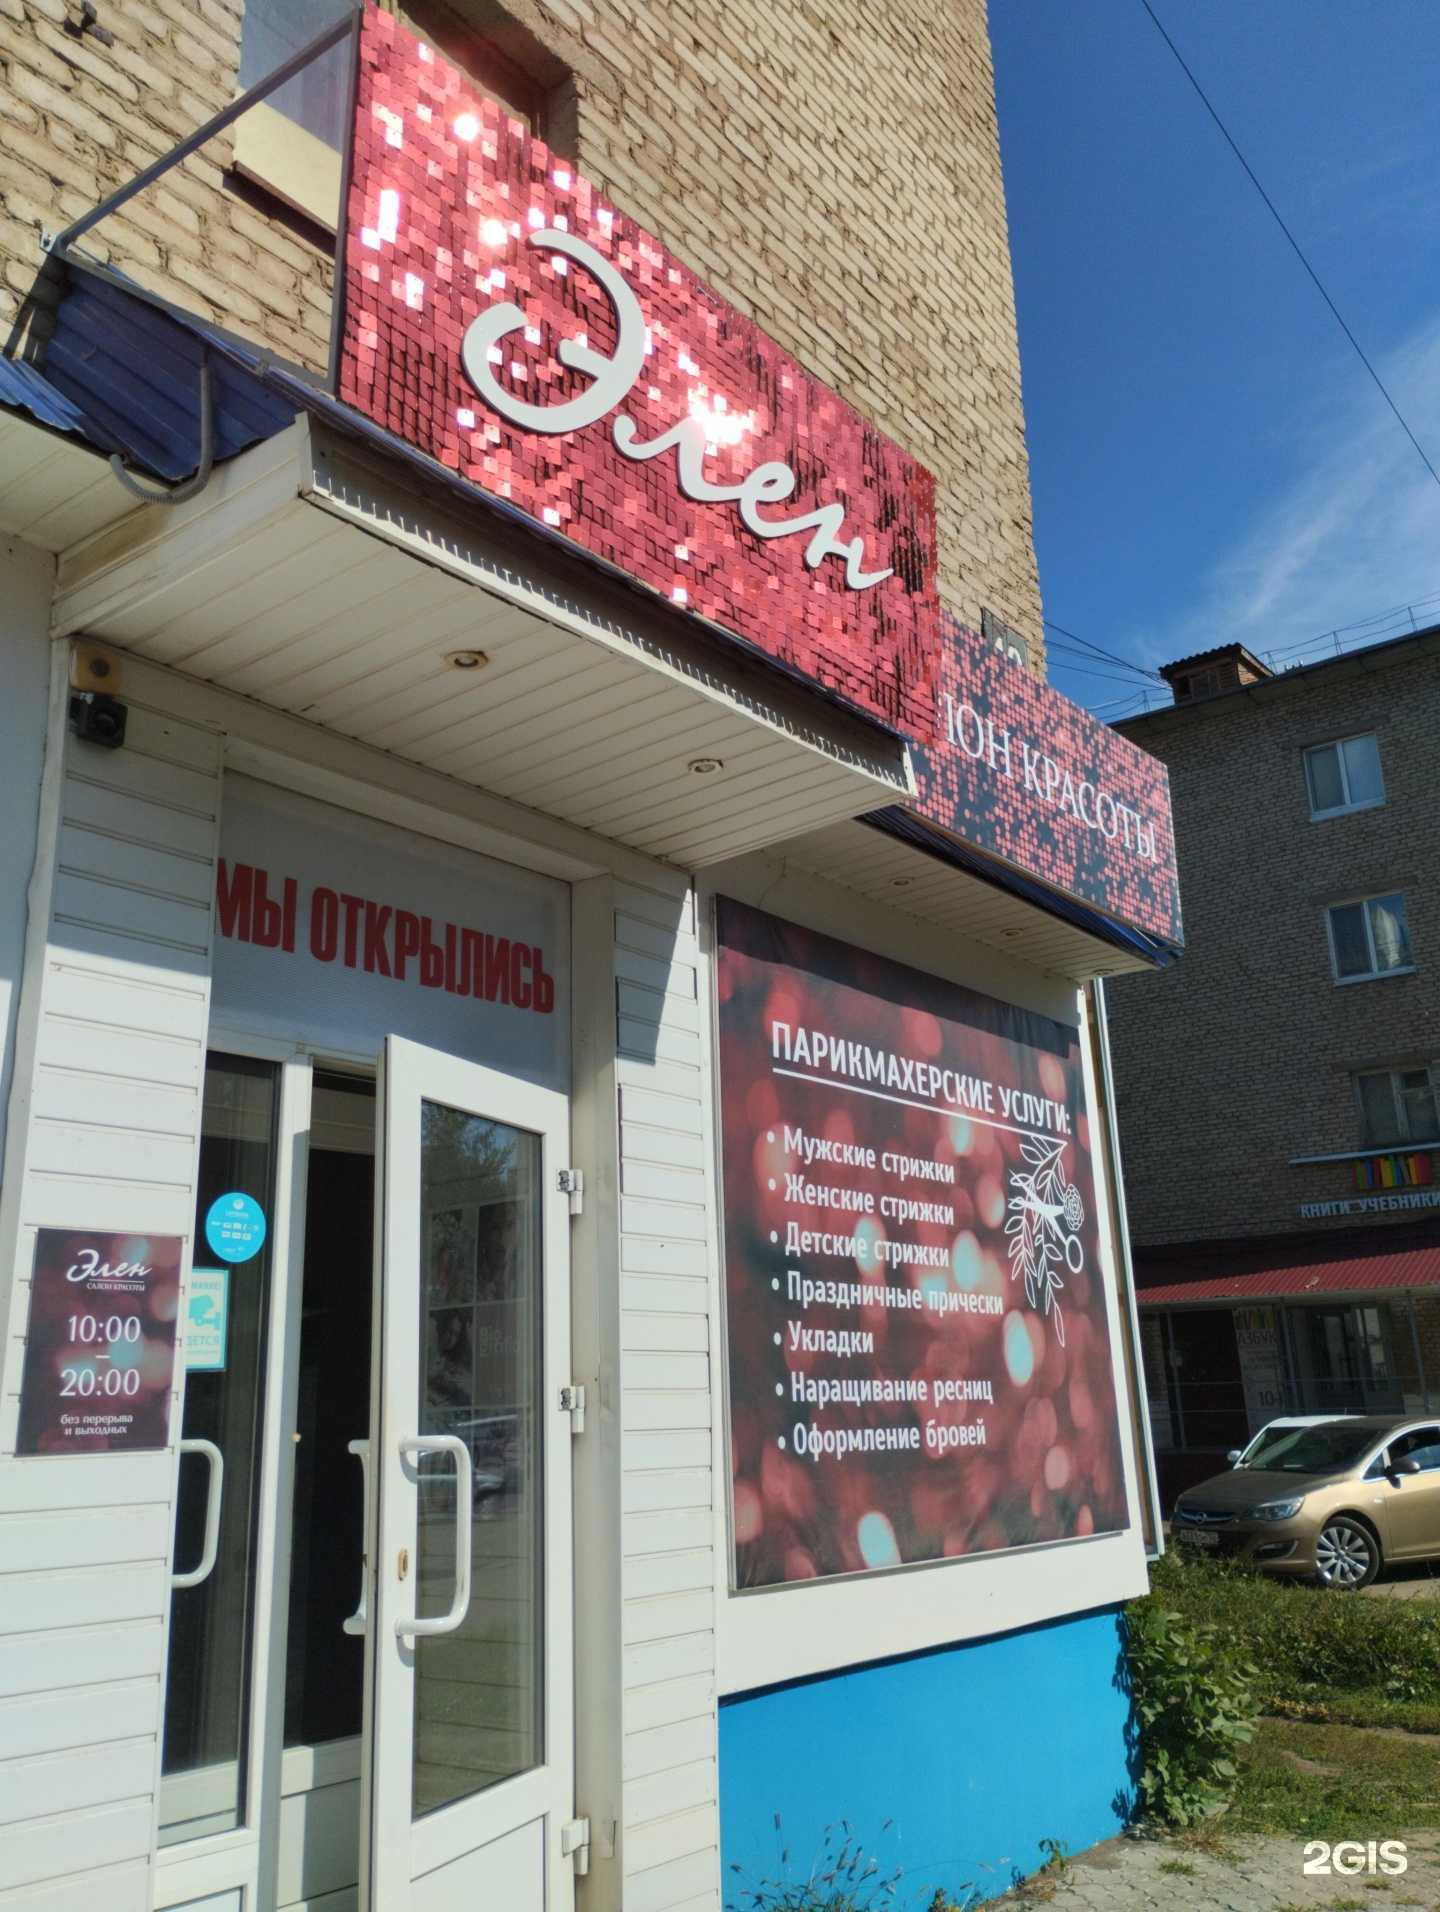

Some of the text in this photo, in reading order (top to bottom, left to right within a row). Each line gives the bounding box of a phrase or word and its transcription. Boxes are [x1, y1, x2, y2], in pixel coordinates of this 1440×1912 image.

[462, 227, 893, 589] Элен
[1021, 742, 1158, 865] КРАСОТЫ
[215, 856, 555, 1015] МЫ ОТКРЫЛИСЬ
[772, 1020, 1072, 1135] ПАРИКМАХЕРСКИЕ УСЛУГИ:
[783, 1125, 956, 1185] Мужские стрижки
[783, 1172, 955, 1226] Женские стрижки
[65, 1248, 152, 1283] Элен
[785, 1221, 950, 1270] Детские стрижки
[787, 1270, 1004, 1319] Праздничные прически
[68, 1314, 141, 1343] 10:00
[787, 1320, 874, 1359] Укладки
[59, 1368, 141, 1397] 20:00
[791, 1371, 993, 1410] Наращивание ресниц
[60, 1413, 133, 1426] без перерыва
[64, 1425, 128, 1436] и выходных
[793, 1417, 987, 1462] Оформление бровей
